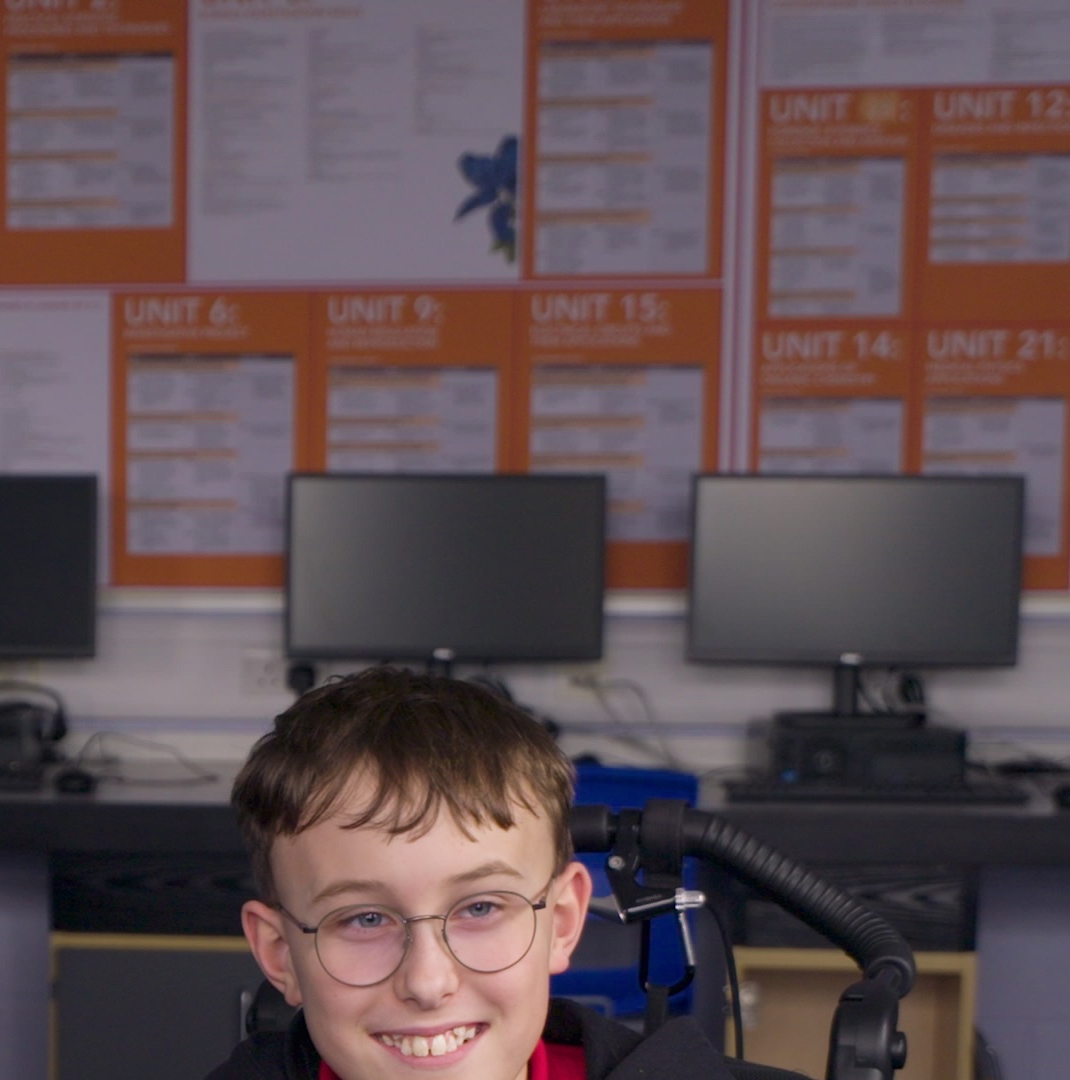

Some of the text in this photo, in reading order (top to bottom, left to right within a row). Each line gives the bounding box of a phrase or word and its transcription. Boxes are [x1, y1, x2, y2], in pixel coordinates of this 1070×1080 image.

[769, 93, 851, 122] UNIT
[933, 89, 1017, 120] UNIT
[124, 296, 201, 325] UNIT
[209, 296, 241, 325] 6:
[327, 295, 445, 325] UNIT 9:
[530, 293, 669, 323] UNIT 15:
[762, 330, 902, 359] UNIT 14:
[927, 329, 1070, 360] UNIT 21:
